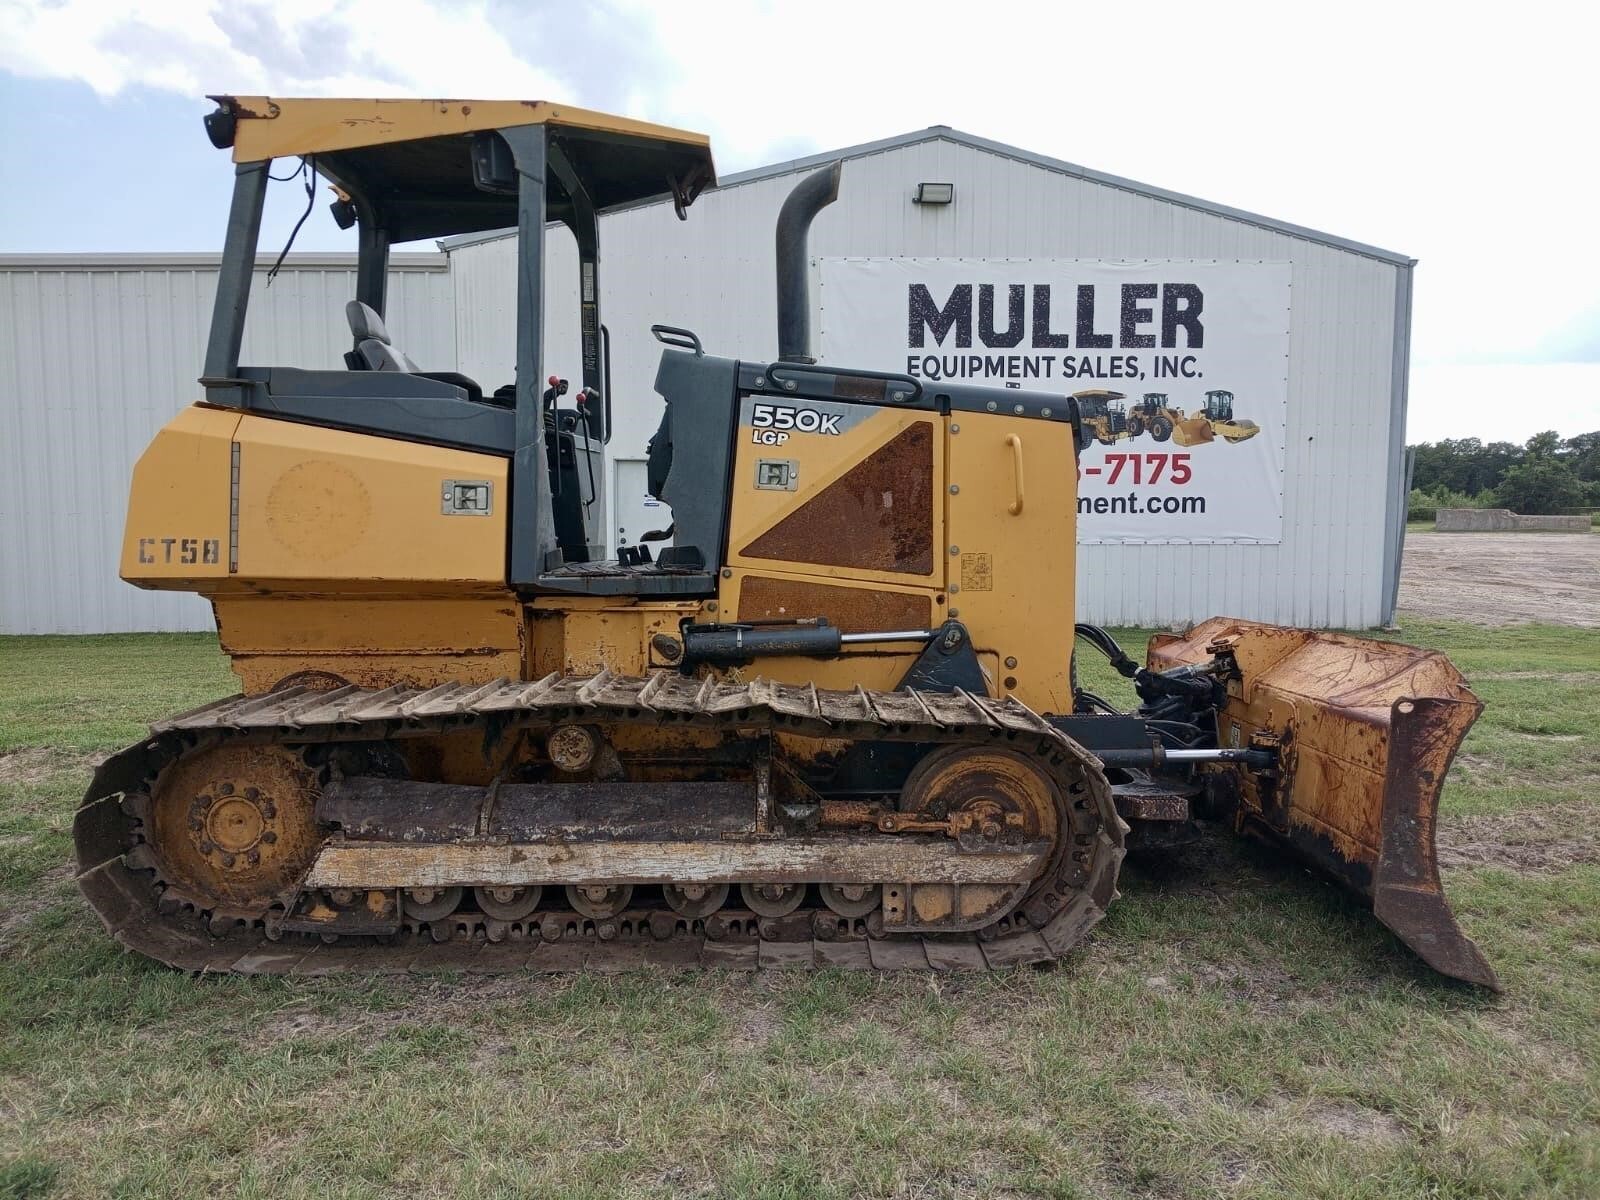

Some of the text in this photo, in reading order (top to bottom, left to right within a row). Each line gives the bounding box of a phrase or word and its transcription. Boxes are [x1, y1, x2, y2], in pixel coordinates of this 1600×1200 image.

[908, 283, 1204, 348] MULLER
[907, 355, 1203, 381] EQUIPMENT SALES, INC.
[752, 403, 844, 435] 550K
[752, 428, 790, 447] LGP
[1077, 453, 1192, 485] -7175
